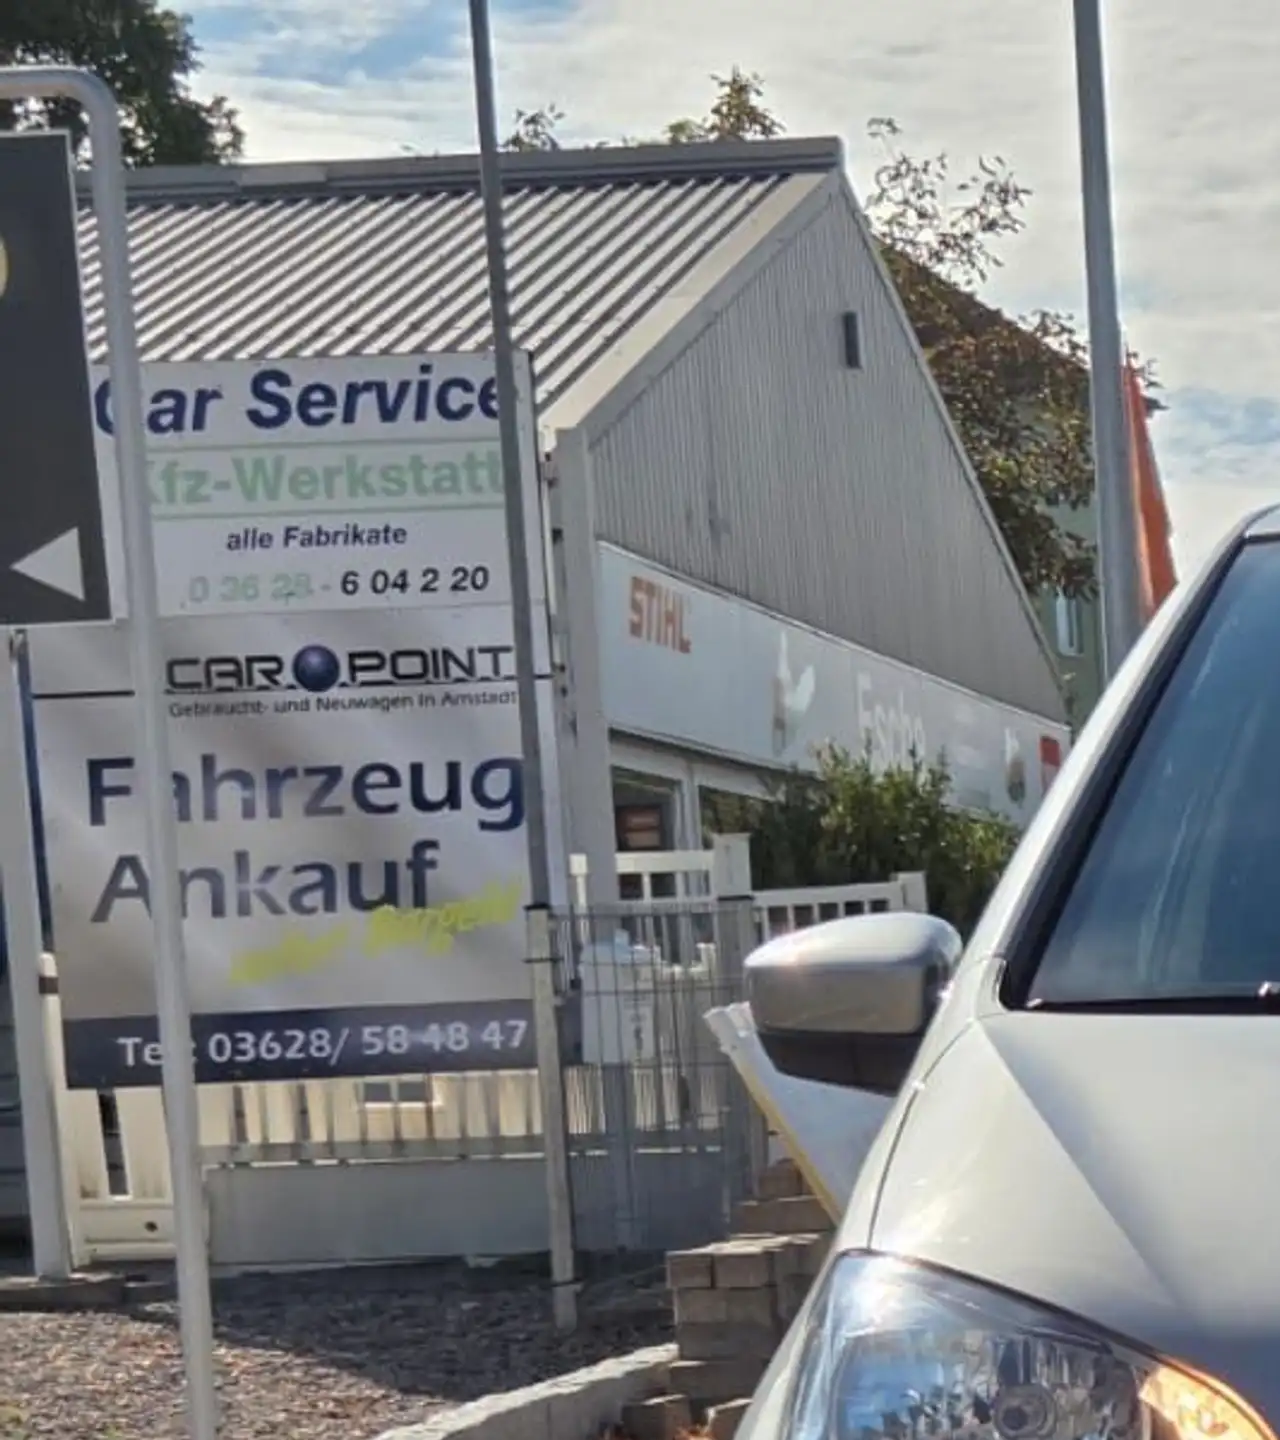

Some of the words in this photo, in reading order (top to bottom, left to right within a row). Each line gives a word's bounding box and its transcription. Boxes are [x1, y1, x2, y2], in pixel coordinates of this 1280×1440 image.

[227, 527, 274, 551] alle
[283, 522, 407, 548] Fabrikate
[629, 576, 692, 654] STIHL
[167, 654, 283, 688] CAR
[348, 645, 513, 684] POINT
[273, 695, 310, 714] und
[316, 694, 414, 713] Neuwagen
[91, 840, 439, 923] Ankauf
[208, 1028, 350, 1066] 03628/
[361, 1025, 409, 1056] 58
[421, 1022, 469, 1053] 48
[480, 1020, 528, 1050] 47
